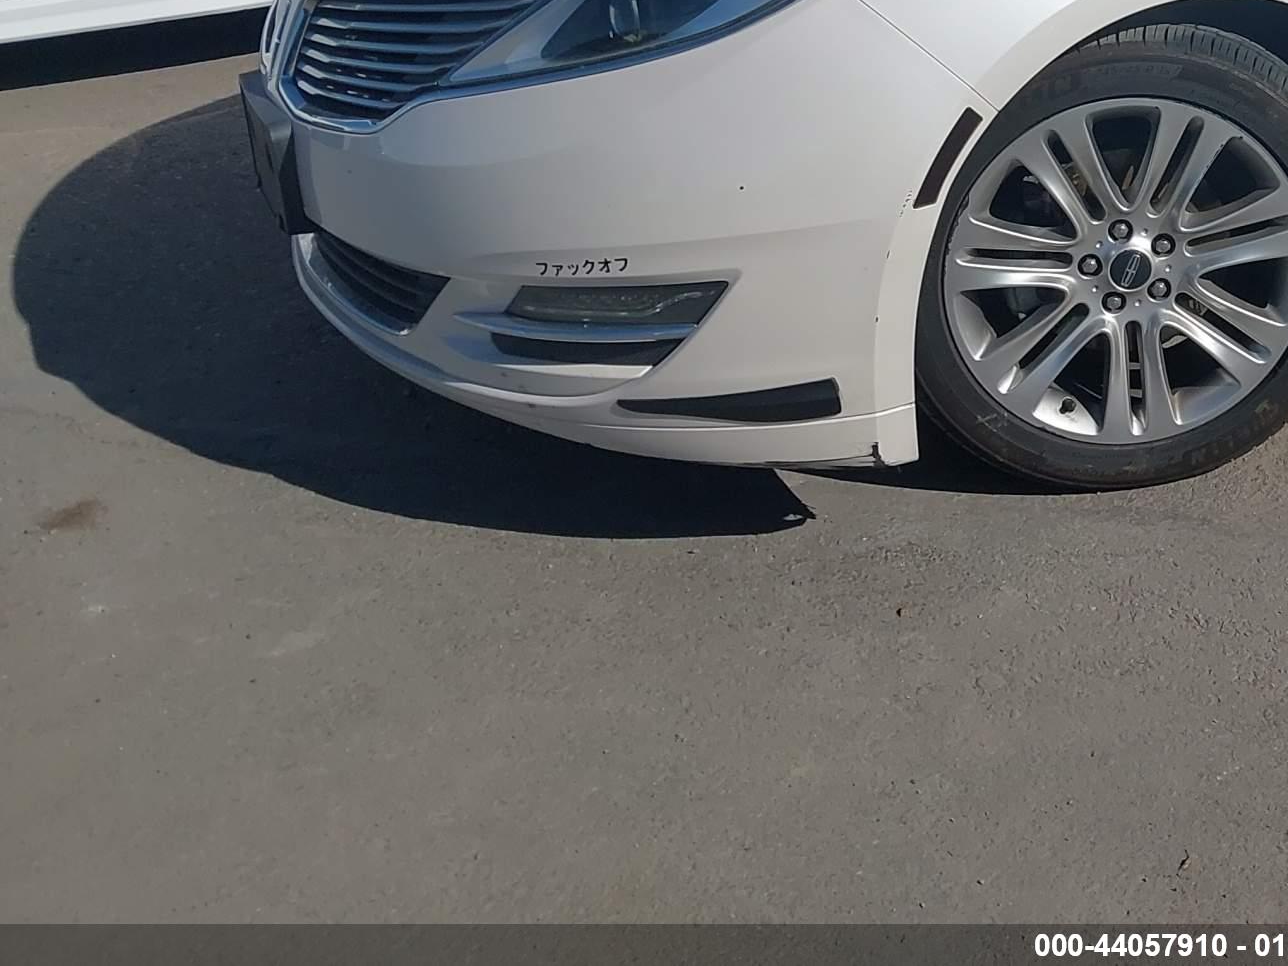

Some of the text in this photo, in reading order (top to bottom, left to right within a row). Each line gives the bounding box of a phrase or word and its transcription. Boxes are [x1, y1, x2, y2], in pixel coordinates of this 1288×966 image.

[536, 257, 628, 276] ファックオフ
